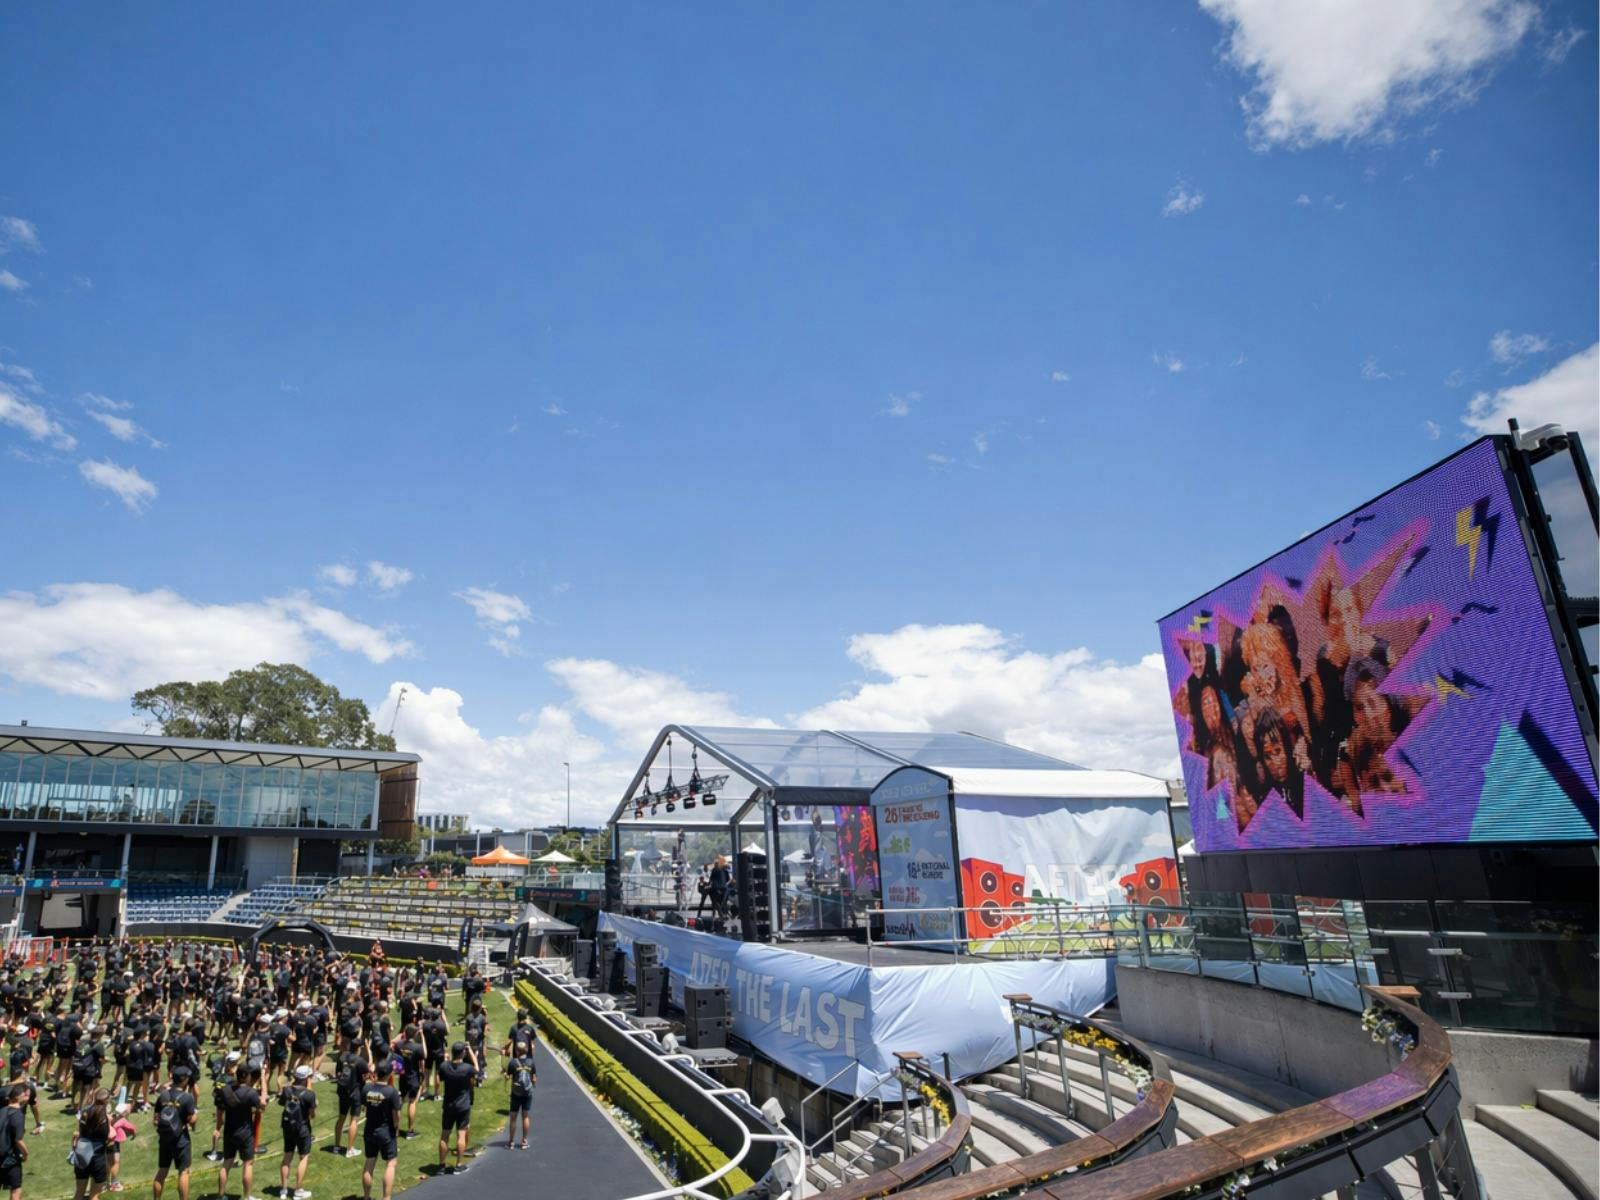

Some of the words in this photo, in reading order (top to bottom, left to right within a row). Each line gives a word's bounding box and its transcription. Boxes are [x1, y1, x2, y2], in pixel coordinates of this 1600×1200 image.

[1023, 864, 1127, 905] AFTER
[736, 968, 775, 1024] THE
[780, 980, 865, 1059] LAST
